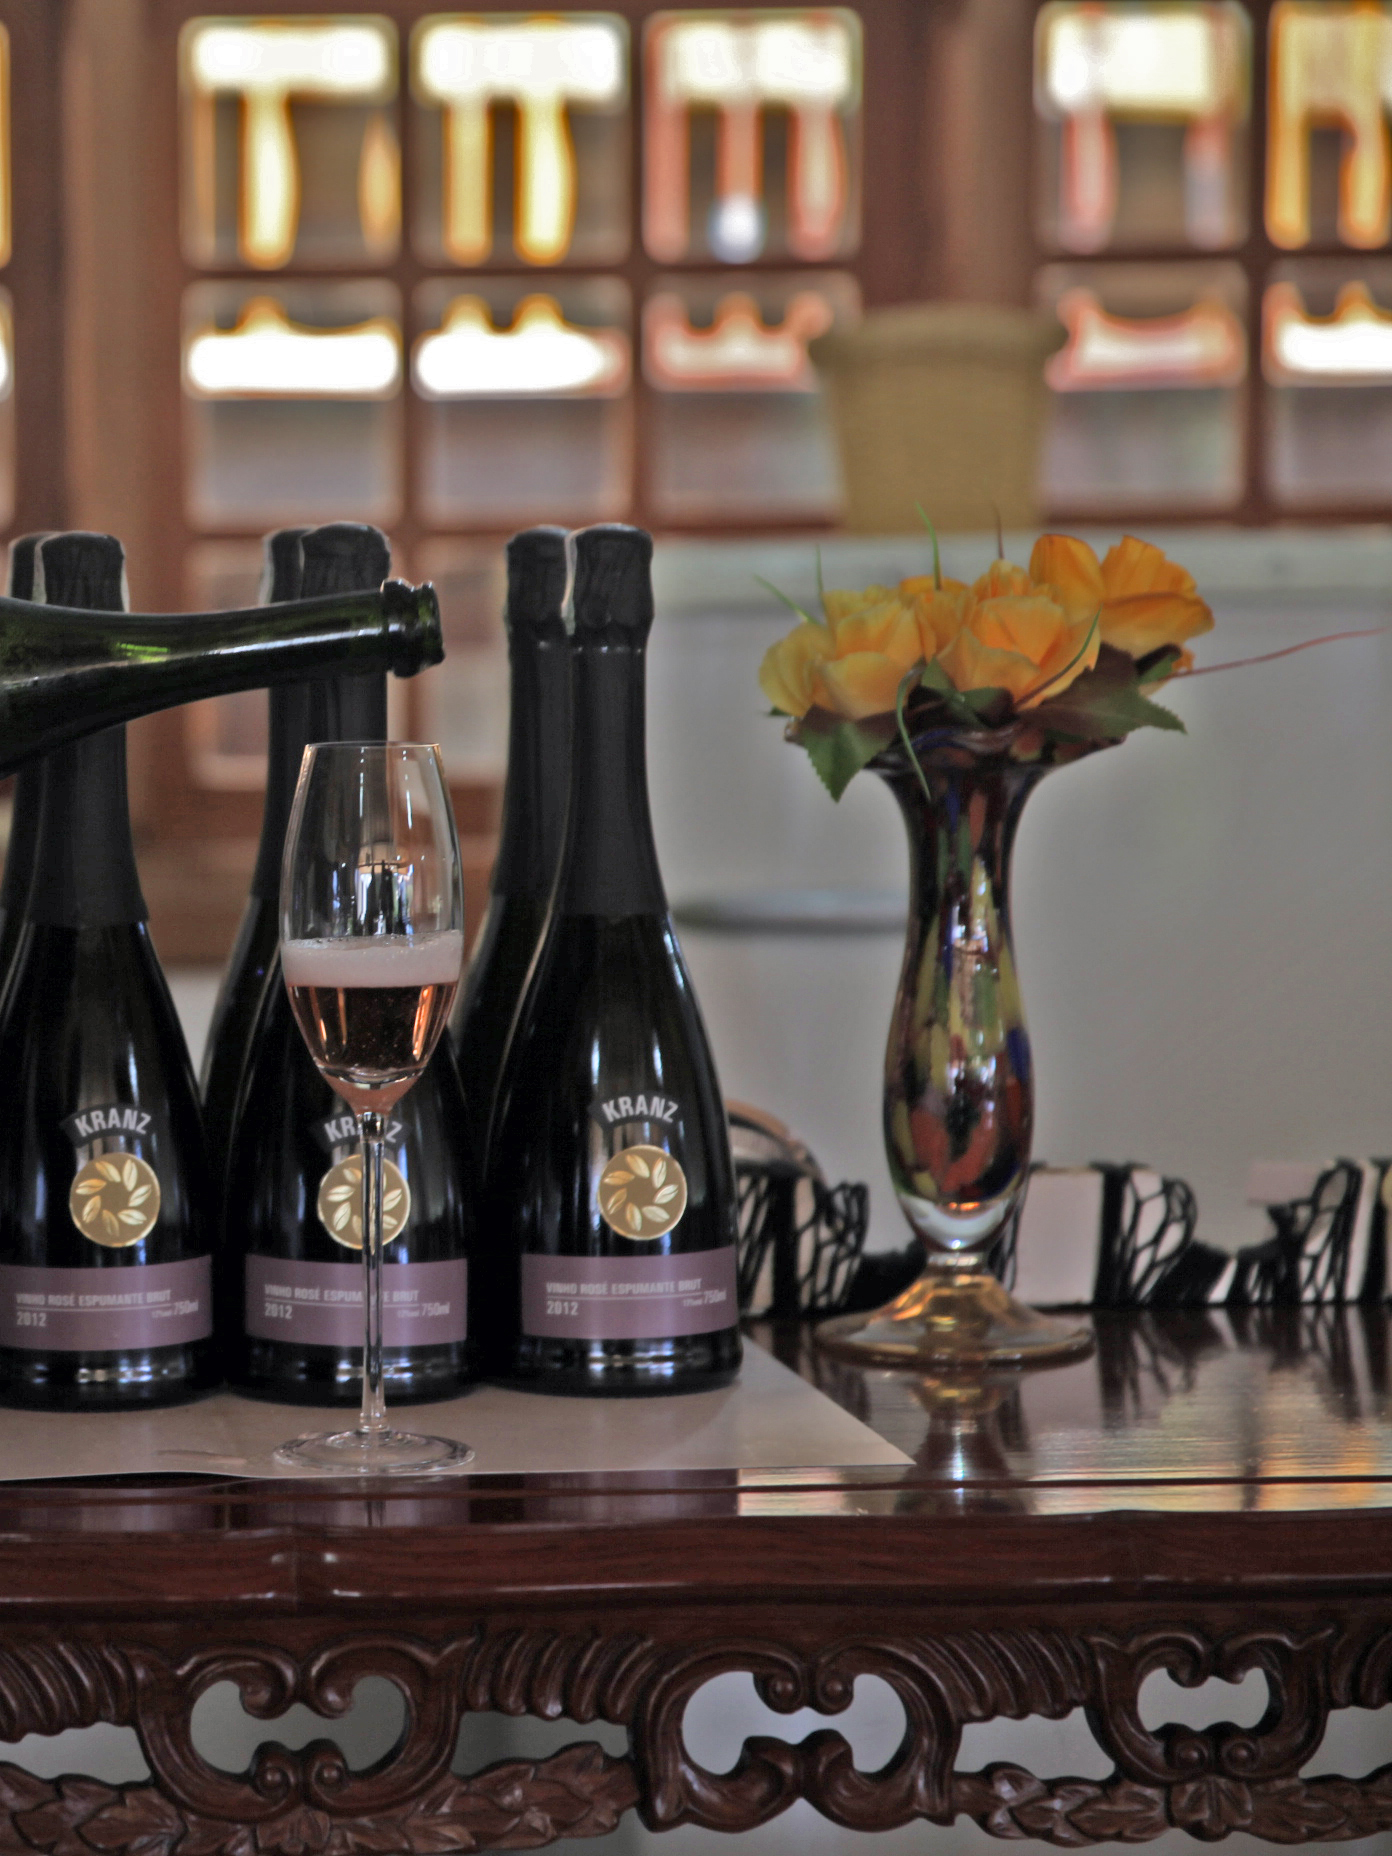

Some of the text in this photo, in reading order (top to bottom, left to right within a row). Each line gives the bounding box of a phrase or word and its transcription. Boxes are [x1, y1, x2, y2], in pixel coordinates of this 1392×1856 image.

[601, 1095, 678, 1123] KRANZ
[74, 1108, 151, 1137] KRANZ
[324, 1116, 402, 1143] KRZ
[323, 1289, 390, 1302] ESPUME
[611, 1281, 675, 1295] ESPUMANTE
[264, 1303, 293, 1320] 2012
[546, 1301, 578, 1316] 2012
[16, 1311, 47, 1327] 2012
